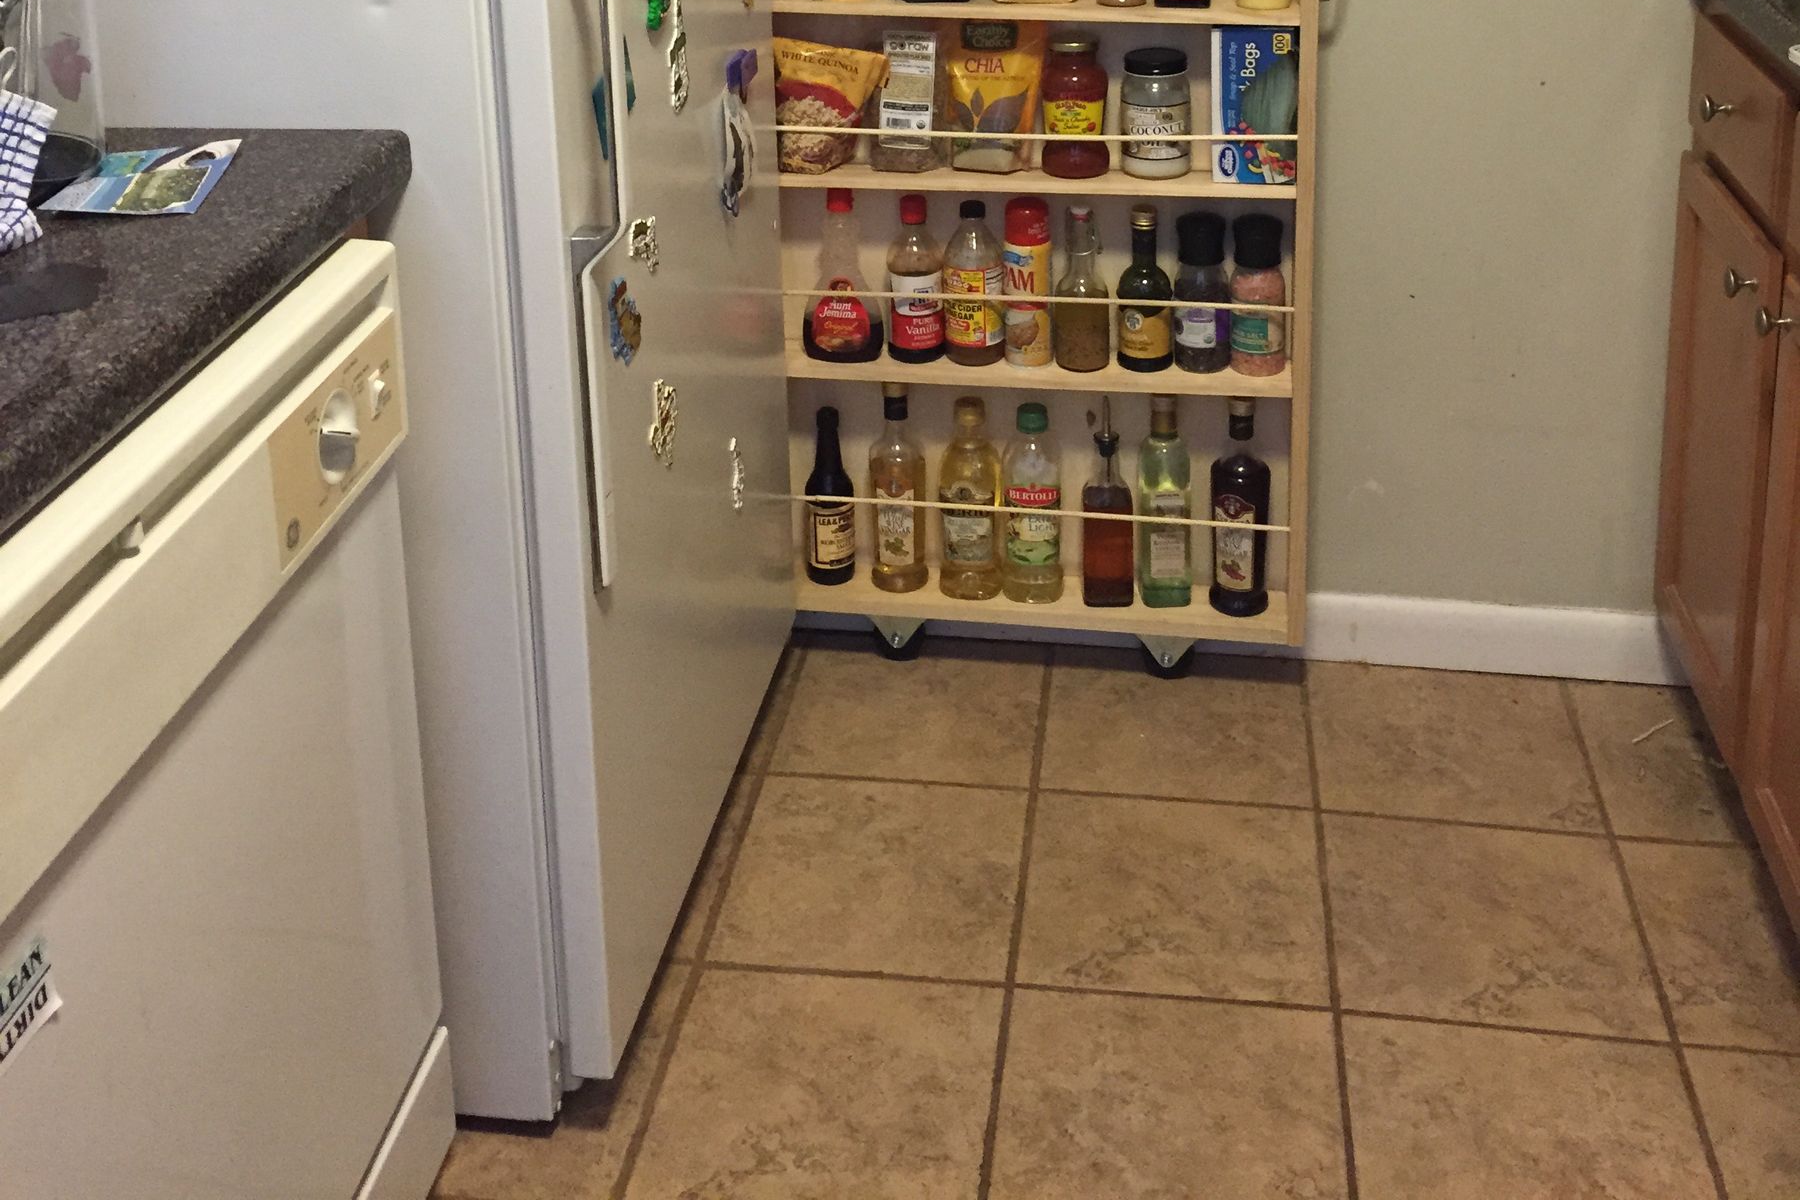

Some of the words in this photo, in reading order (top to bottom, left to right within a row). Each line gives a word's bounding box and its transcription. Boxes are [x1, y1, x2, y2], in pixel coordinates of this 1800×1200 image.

[972, 37, 1011, 48] Choice
[1274, 35, 1286, 52] 100
[781, 50, 815, 64] WHITE
[817, 57, 860, 75] QUINOA
[964, 58, 1005, 73] CHIA
[1240, 42, 1261, 77] Bags
[1130, 120, 1184, 136] COCONUT
[819, 306, 857, 318] Jemima
[828, 301, 852, 310] Aunt
[957, 304, 983, 312] CIDER
[905, 321, 940, 335] Vanilla
[1009, 489, 1057, 501] BERTOLLI
[0, 944, 44, 1017] LEAN
